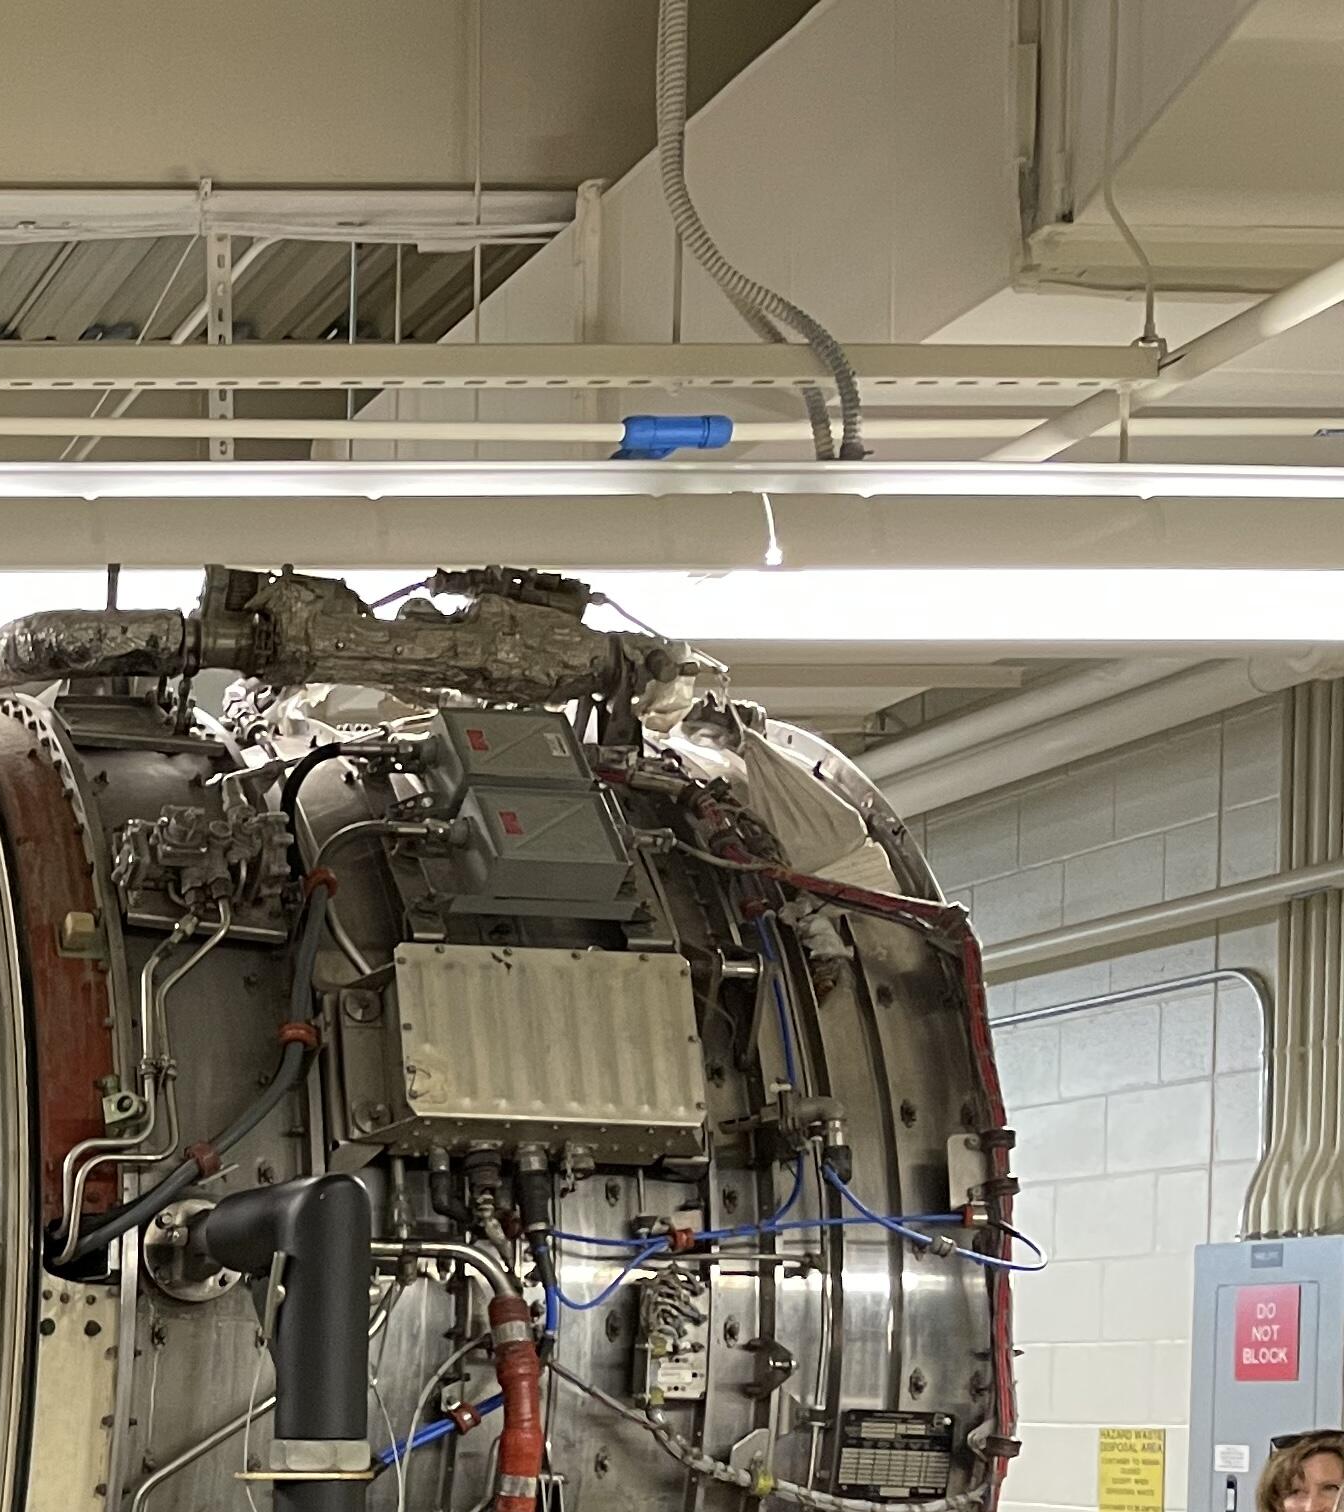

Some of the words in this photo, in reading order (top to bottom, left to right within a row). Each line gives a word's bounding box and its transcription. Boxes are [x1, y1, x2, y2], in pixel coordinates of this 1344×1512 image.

[1257, 1303, 1276, 1319] DO
[1251, 1325, 1280, 1342] NOT
[1243, 1348, 1288, 1365] BLOCK
[1141, 1442, 1163, 1453] AREA
